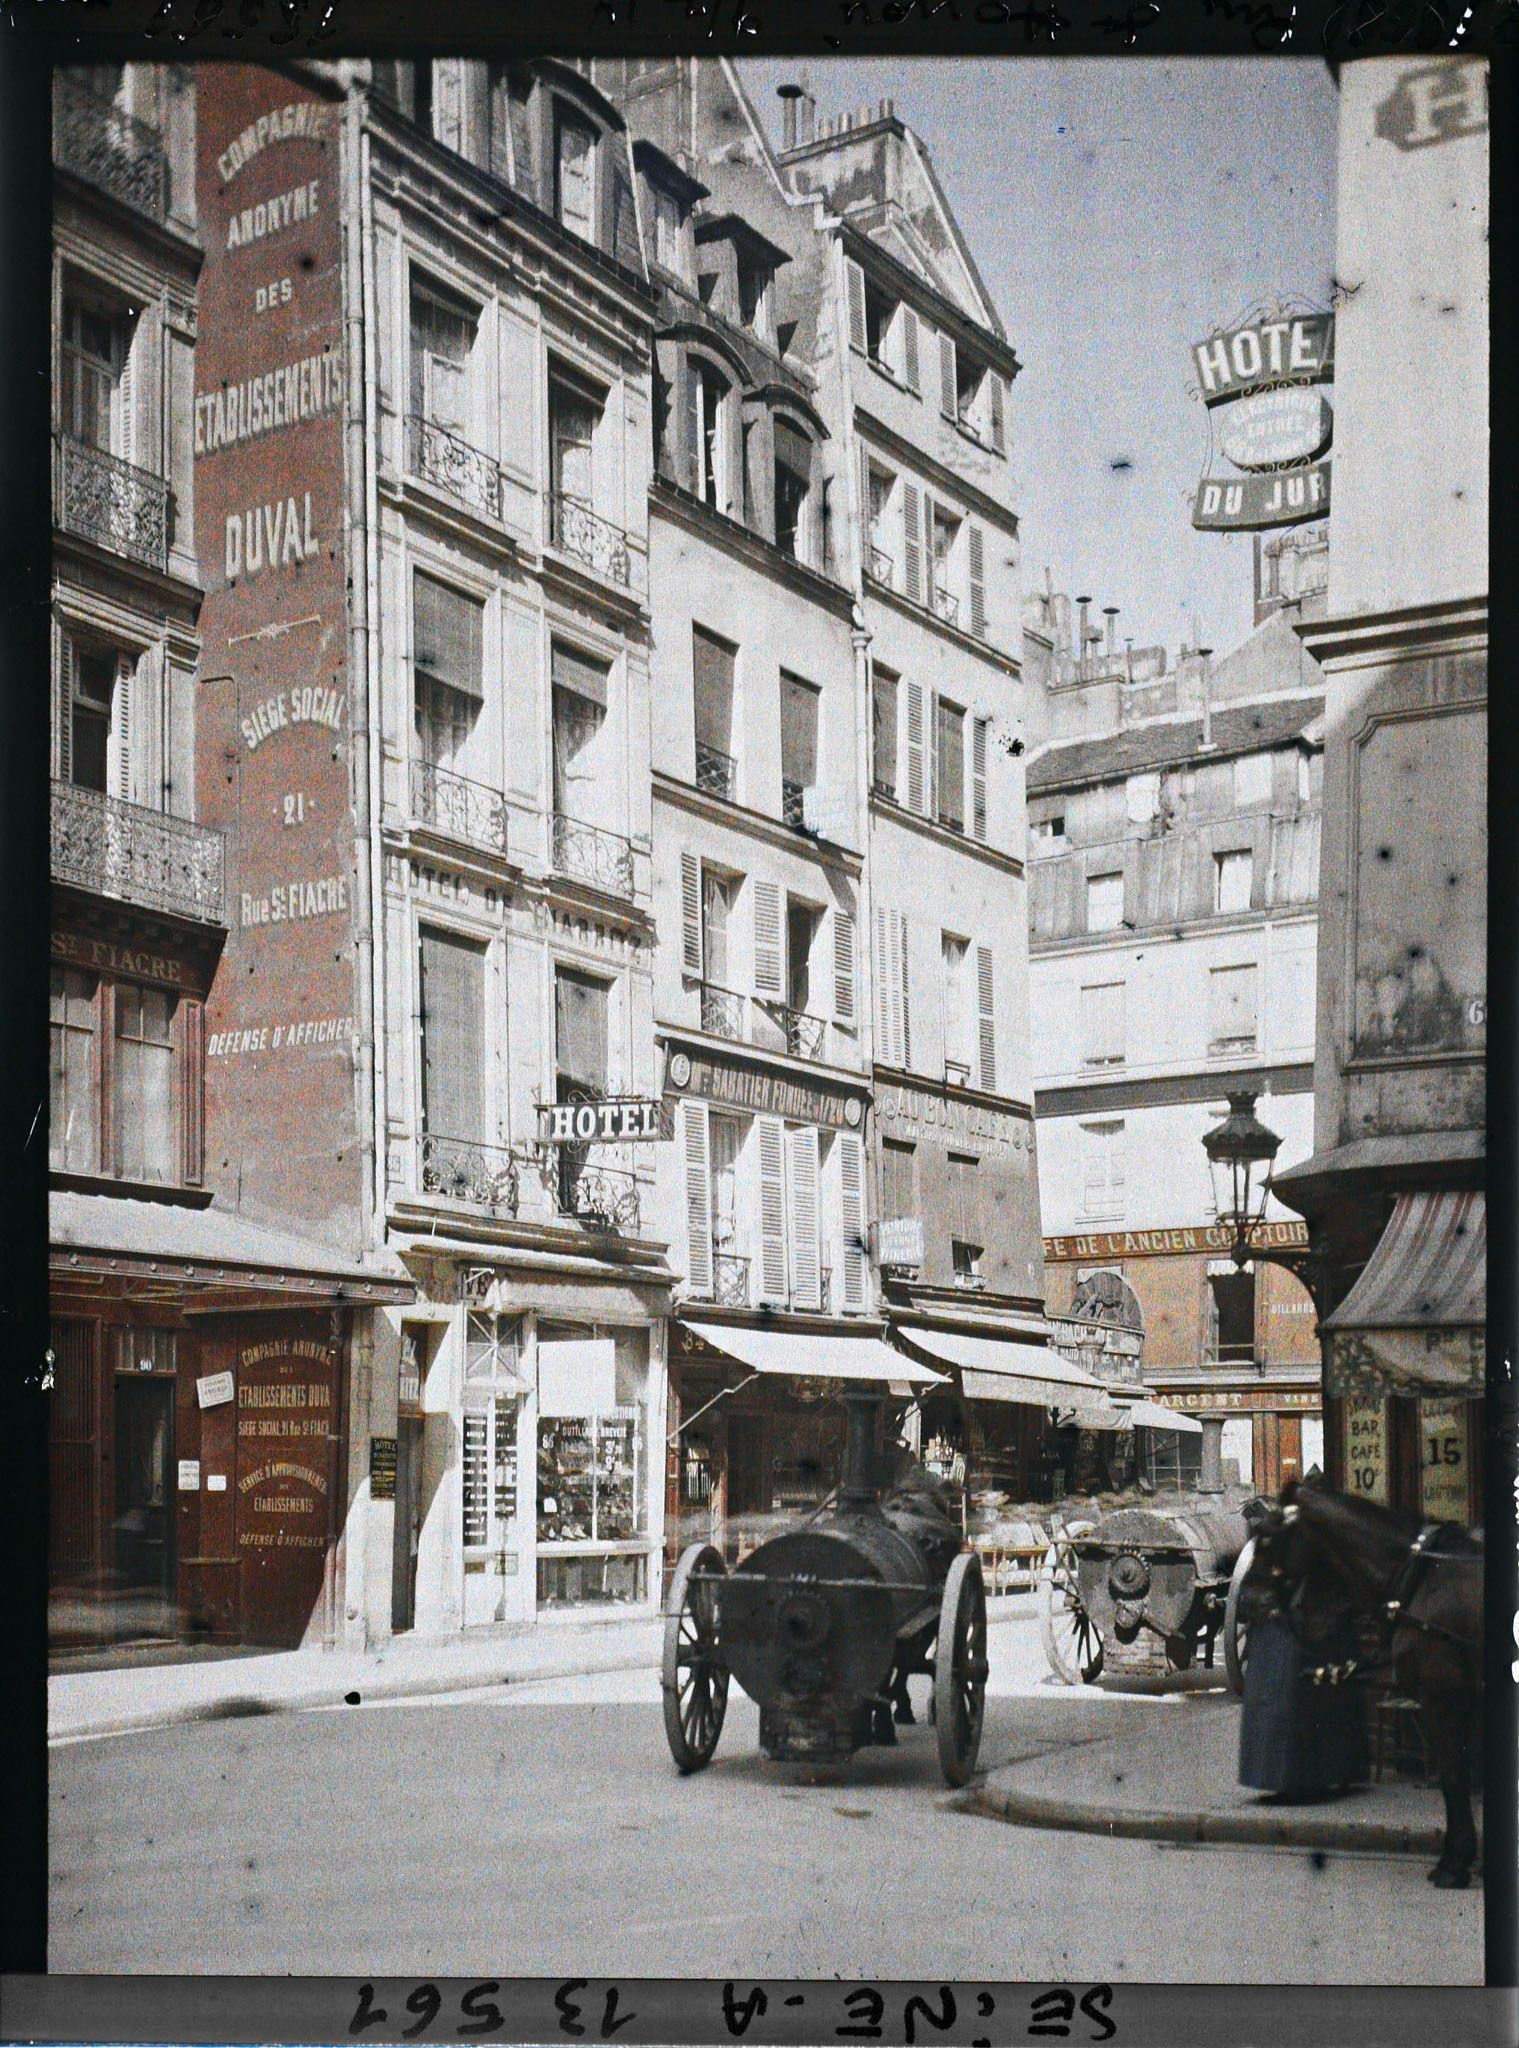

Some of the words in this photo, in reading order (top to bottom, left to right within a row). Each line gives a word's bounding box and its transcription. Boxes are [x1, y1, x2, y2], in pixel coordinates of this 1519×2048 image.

[227, 180, 319, 249] ANONYME
[256, 278, 292, 313] DES
[1202, 484, 1243, 516] DU
[225, 491, 319, 577] DUVAL
[291, 687, 345, 733] SOCIAL
[283, 792, 304, 824] 21
[552, 1104, 658, 1139] HOTEL
[1075, 1235, 1099, 1255] DE
[1107, 1228, 1196, 1253] L'ANCIEN
[1283, 1394, 1318, 1404] VINS
[1427, 1437, 1462, 1466] 15
